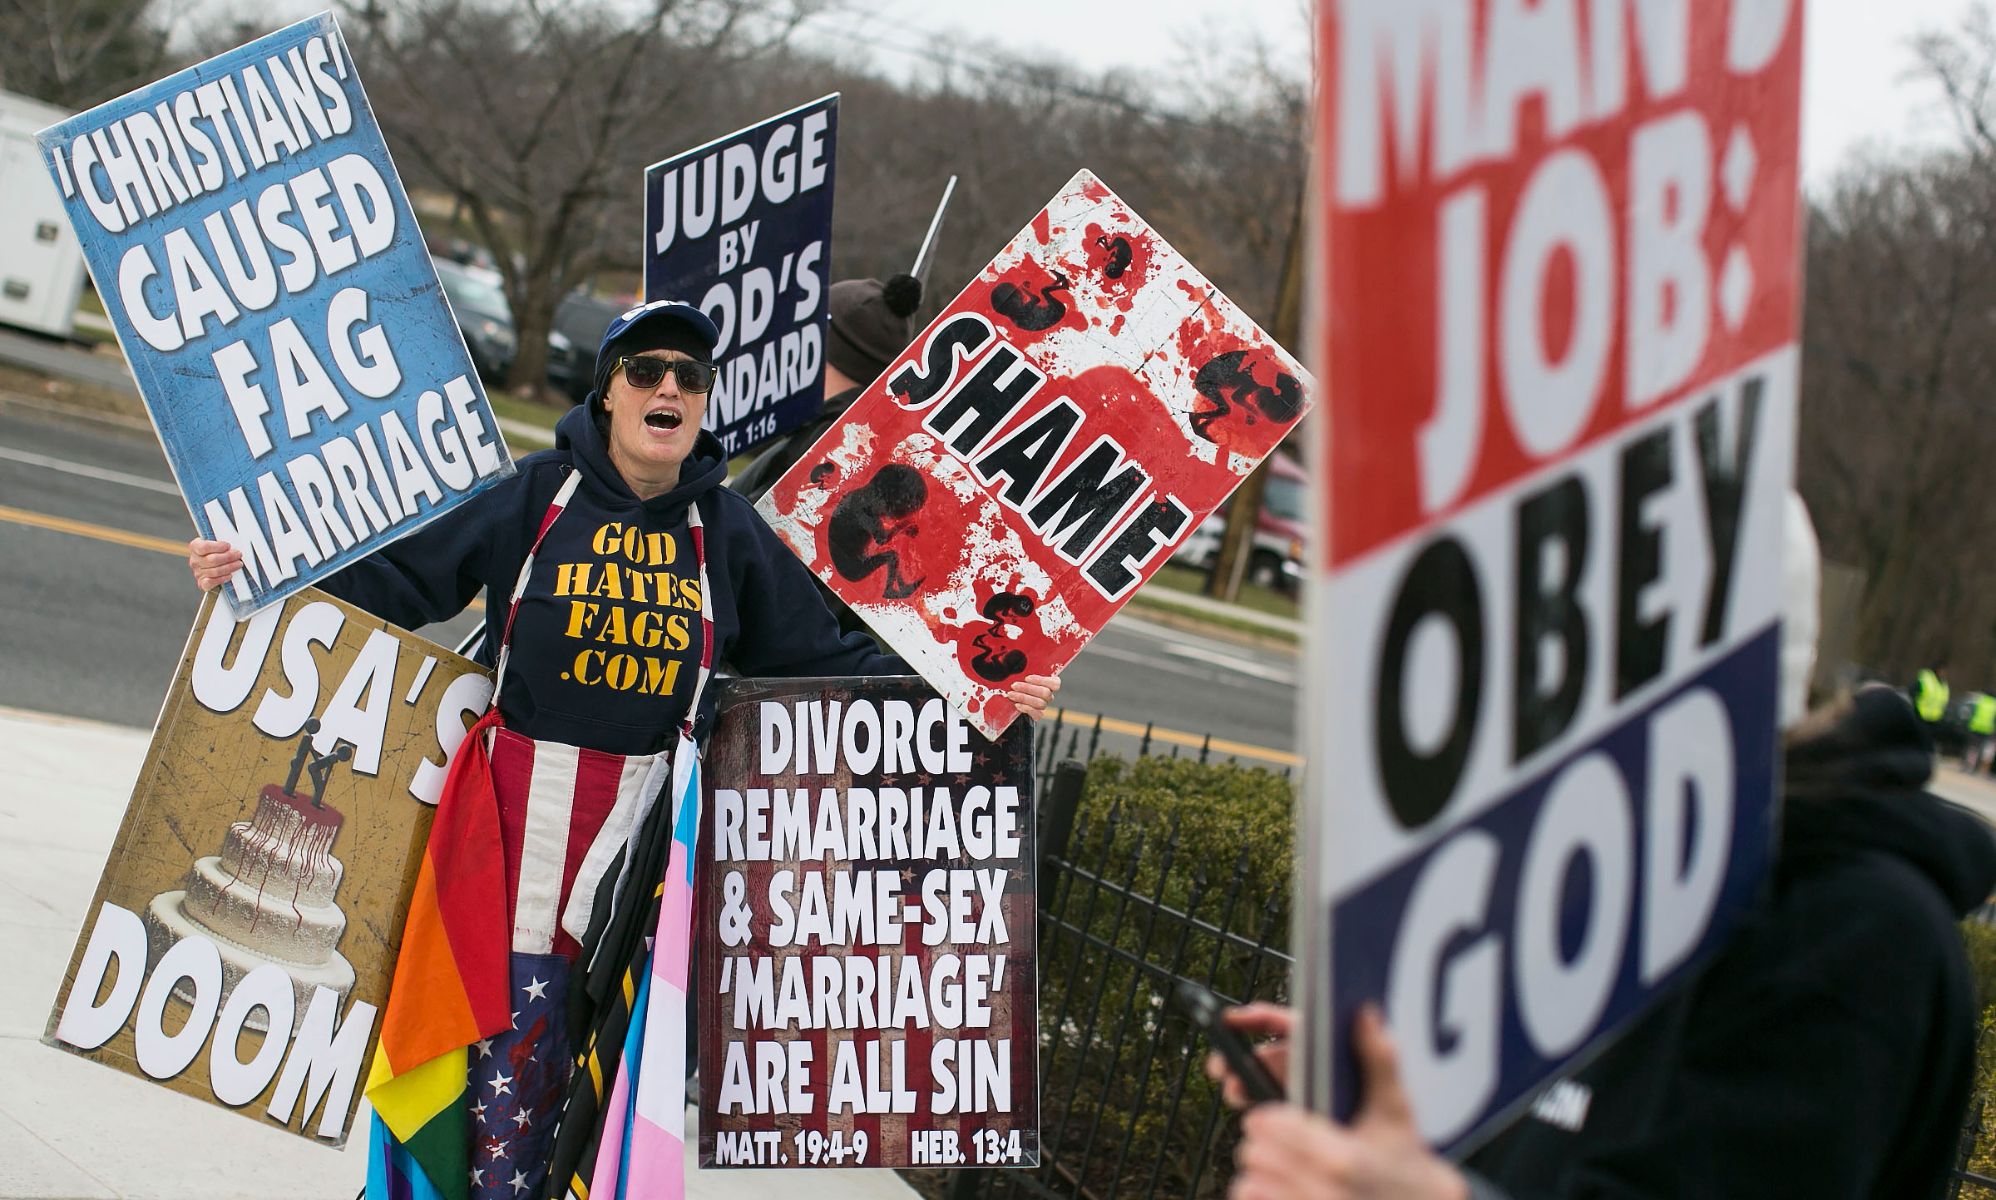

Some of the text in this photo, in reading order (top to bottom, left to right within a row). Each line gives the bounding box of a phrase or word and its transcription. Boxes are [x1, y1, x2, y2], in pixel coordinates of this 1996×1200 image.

[52, 32, 352, 233] 'CHRISTIANS'
[656, 110, 828, 255] JUDGE
[118, 154, 397, 352] CAUSED
[677, 240, 823, 360] OD'S
[718, 220, 760, 276] BY
[1415, 107, 1758, 516] JOB:
[211, 287, 402, 460] FAG
[701, 323, 822, 433] NDARD
[745, 412, 777, 445] 1:16
[204, 374, 500, 601] MARRIAGE
[887, 313, 1192, 600] SHAME
[553, 562, 702, 612] HATES
[592, 522, 676, 566] GOD
[564, 600, 690, 651] FAGS
[1371, 375, 1765, 833] OBEY
[191, 590, 494, 806] USA'S
[560, 649, 682, 696] .COM
[760, 698, 972, 775] DIVORCE
[715, 785, 1021, 862] REMARRIAGE
[718, 868, 1009, 947] & SAME-SEX
[1385, 686, 1735, 1148] GOD
[58, 901, 378, 1139] DOOM
[720, 954, 1006, 1031] 'MARRIAGE'
[718, 1037, 1012, 1115] ARE ALL SIN
[715, 1129, 1022, 1165] MATT. 19:4-9 HEB. 13:4
